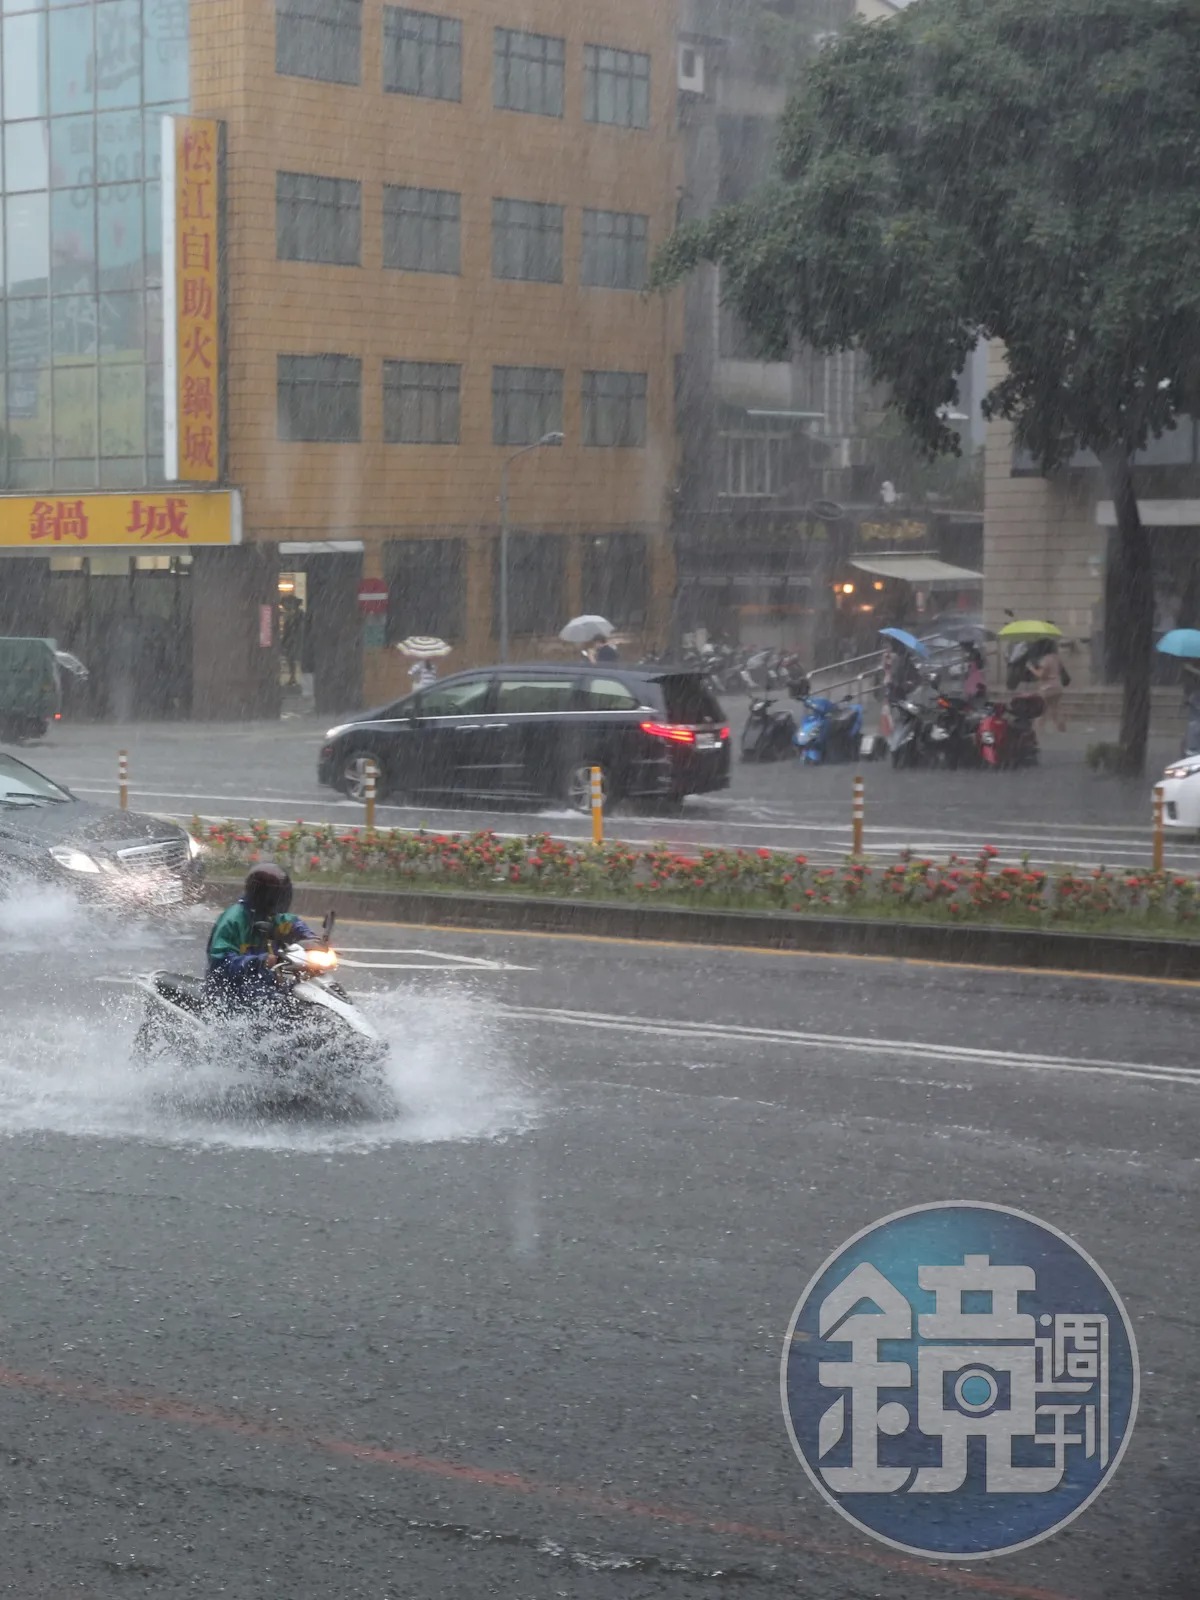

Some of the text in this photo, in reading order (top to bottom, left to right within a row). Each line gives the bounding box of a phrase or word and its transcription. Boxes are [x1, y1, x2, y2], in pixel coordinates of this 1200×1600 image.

[181, 126, 214, 470] 松江自助火鍋城
